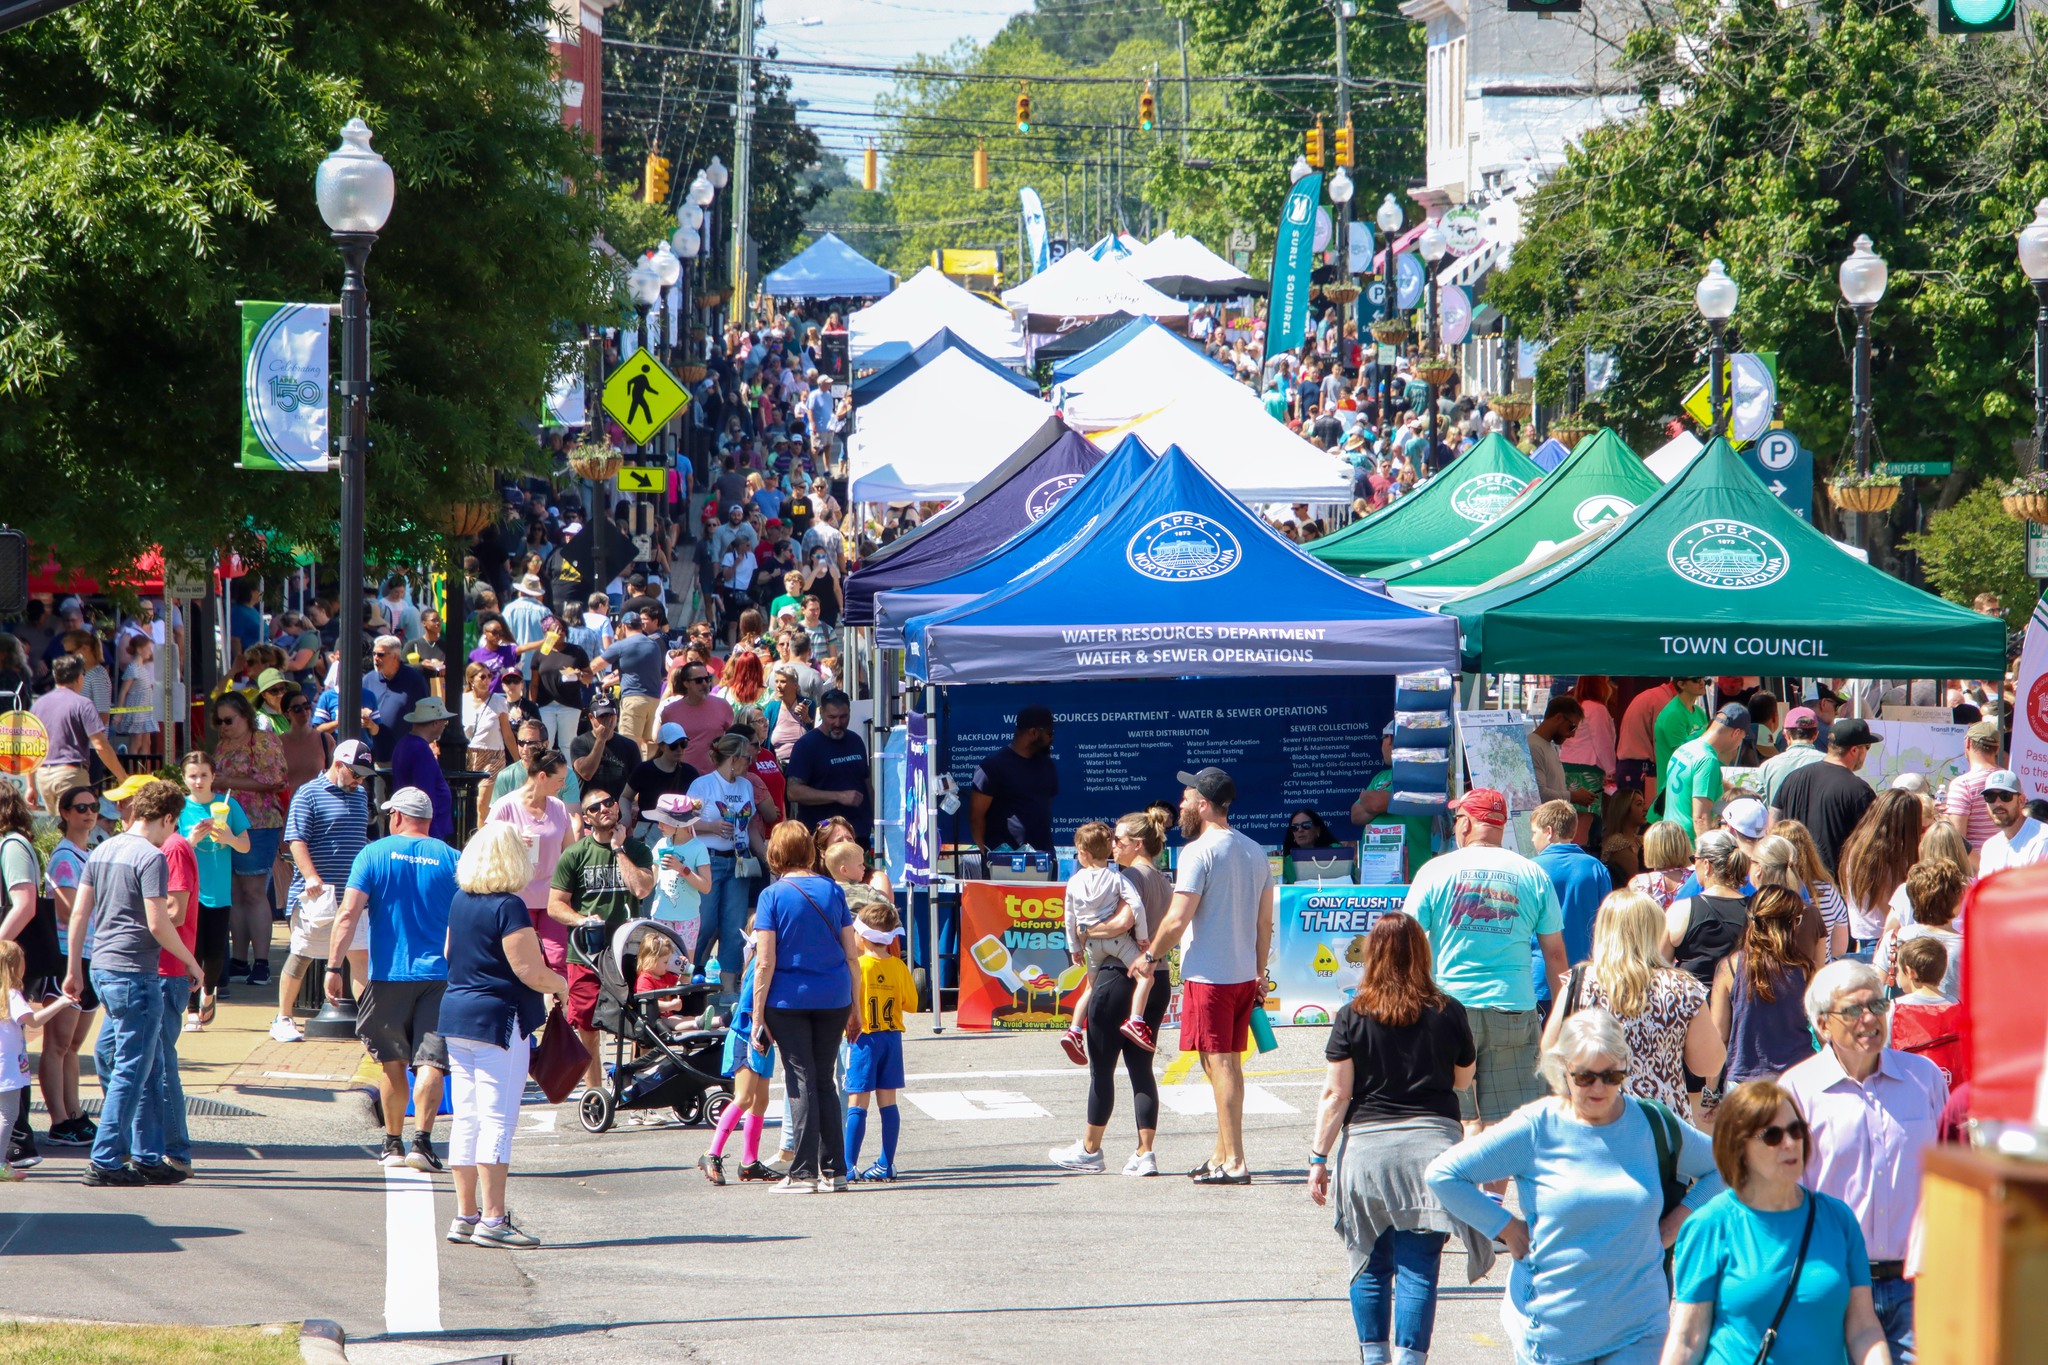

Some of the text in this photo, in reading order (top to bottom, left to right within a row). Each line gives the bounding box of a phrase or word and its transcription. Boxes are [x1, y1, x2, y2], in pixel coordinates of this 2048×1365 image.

[1235, 234, 1251, 247] 25
[1283, 230, 1299, 335] SURLY SQUIRREL
[1374, 288, 1384, 300] P
[269, 360, 321, 377] Celebrating
[268, 376, 322, 412] 150
[1771, 441, 1786, 462] P
[1476, 476, 1513, 486] APEX
[1457, 500, 1485, 520] NORTH
[1160, 516, 1208, 530] APEX
[1702, 524, 1752, 538] APEX
[1134, 549, 1234, 578] NORTH CAROLINA
[1676, 556, 1782, 586] NORTH CAROLINA
[1062, 626, 1326, 644] WATER RESOURCES DEPARTMENT
[1660, 637, 1828, 656] TOWN COUNCIL
[1076, 648, 1314, 666] WATER & SEWER OPERATIONS
[1101, 711, 1169, 721] DEPARTMENT
[1178, 710, 1213, 719] WATER
[1216, 709, 1224, 718] &
[1227, 708, 1261, 718] SEWER
[1264, 705, 1328, 716] OPERATIONS
[1156, 729, 1210, 737] DISTRIBUTION
[1319, 723, 1369, 731] COLLECTIONS
[957, 733, 999, 741] BACKFLOW
[0, 738, 46, 757] emonade
[2026, 750, 2048, 762] Pass
[755, 760, 776, 770] AERO
[2021, 765, 2030, 775] to
[1667, 756, 1687, 794] 73
[391, 851, 440, 866] #wegotyou
[1462, 871, 1517, 883] BEACH HOUSE
[1005, 894, 1063, 918] tos
[1308, 897, 1387, 909] ONLY FLUSH
[1014, 920, 1052, 929] before
[1004, 930, 1068, 950] was
[869, 996, 897, 1031] 14
[993, 1018, 1000, 1026] To
